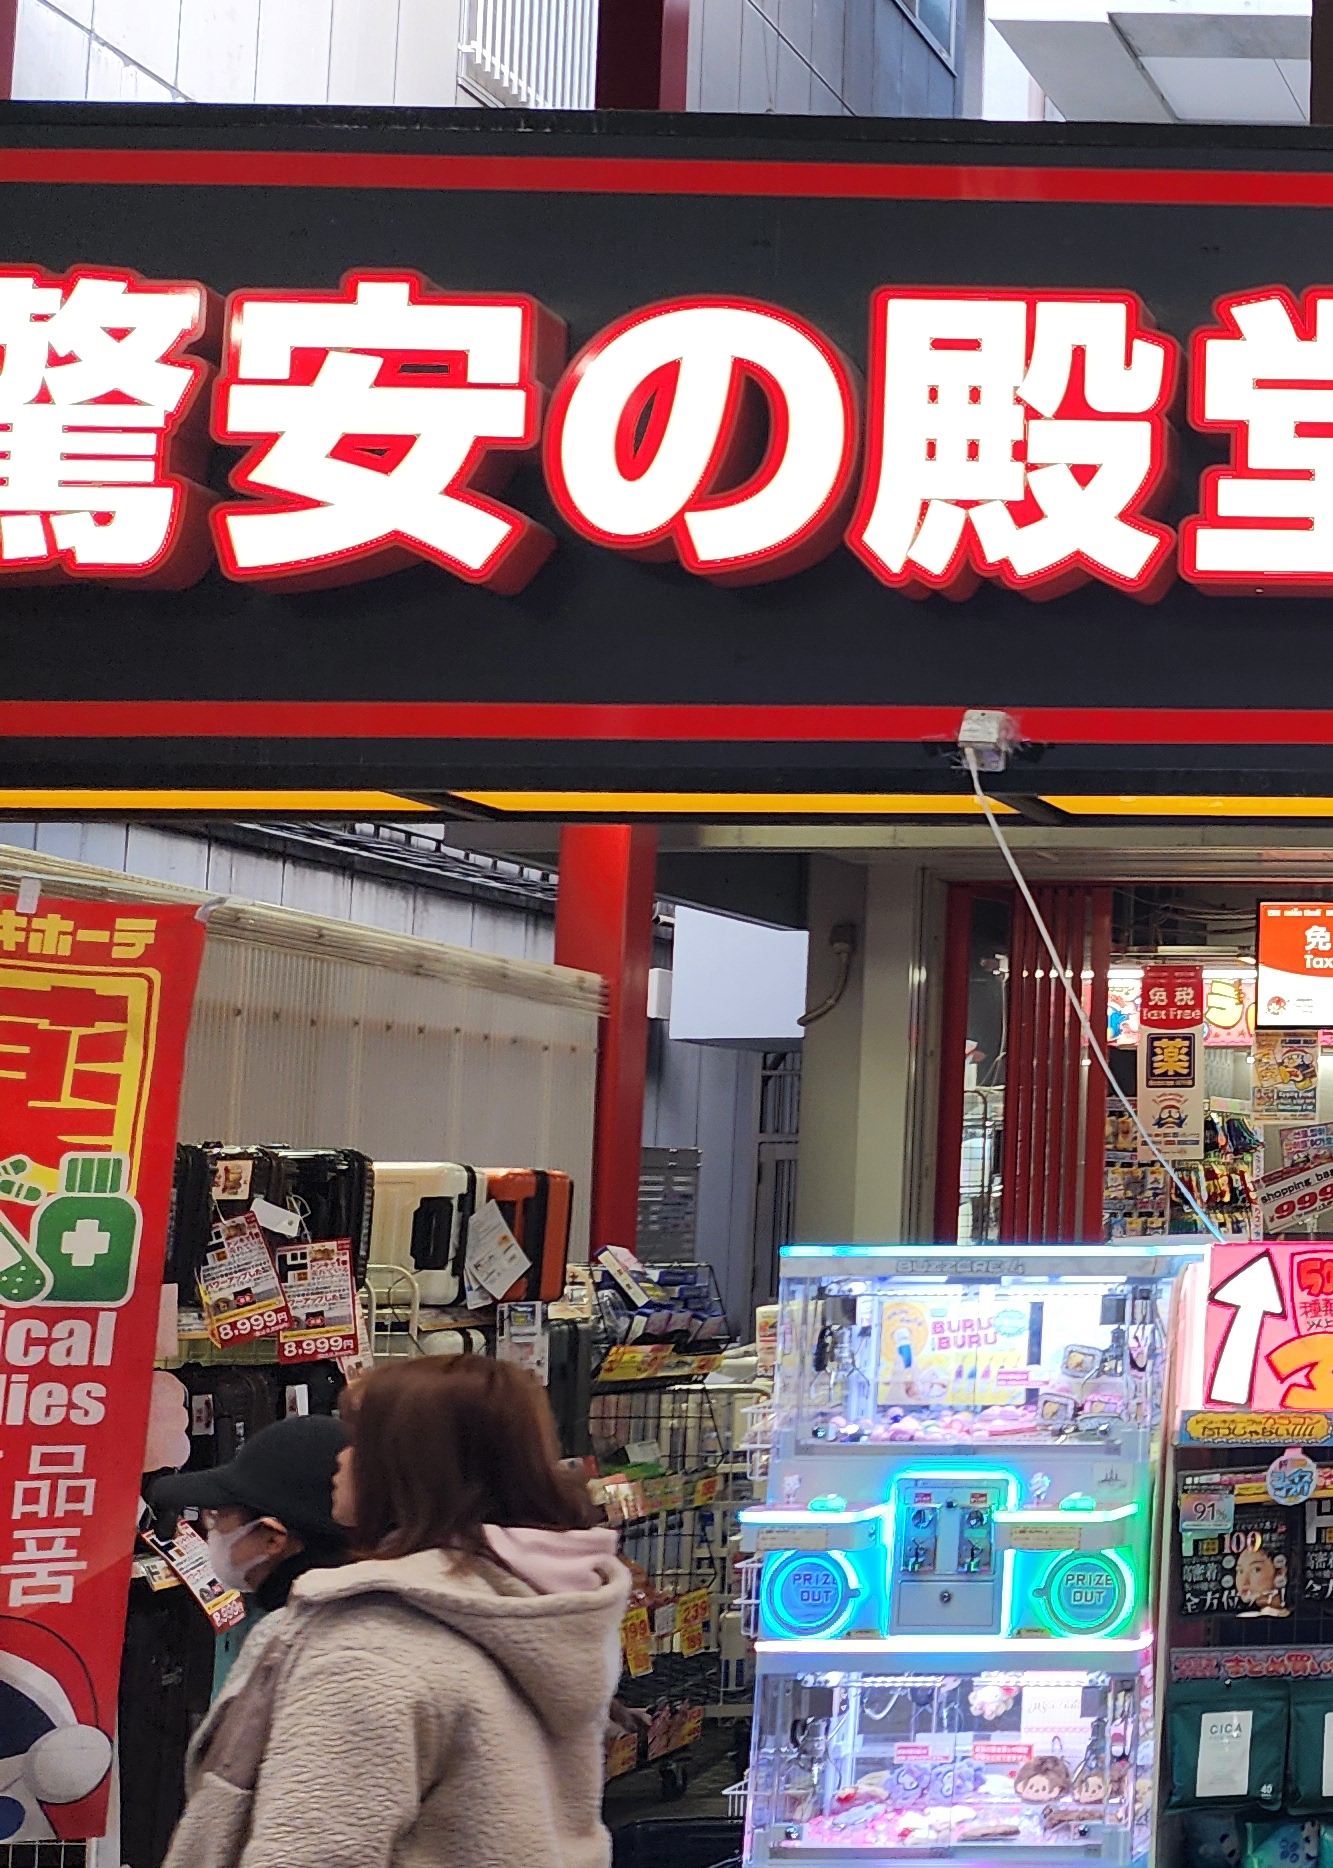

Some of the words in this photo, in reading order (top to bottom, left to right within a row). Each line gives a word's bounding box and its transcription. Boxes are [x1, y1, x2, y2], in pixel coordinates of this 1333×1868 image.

[1142, 1007, 1167, 1020] Tax
[1169, 1007, 1201, 1020] Free
[1152, 1038, 1190, 1076] 薬
[1261, 1178, 1312, 1204] shopping
[931, 1317, 994, 1335] BURU
[0, 1310, 117, 1367] cal
[937, 1331, 998, 1351] BURU
[0, 1374, 107, 1426] ies
[1193, 1502, 1227, 1521] 91%
[1223, 1530, 1263, 1554] 100
[1064, 1573, 1113, 1587] PRIZE
[800, 1589, 834, 1603] OUT
[1071, 1589, 1105, 1604] OUT
[1209, 1722, 1243, 1735] CICA
